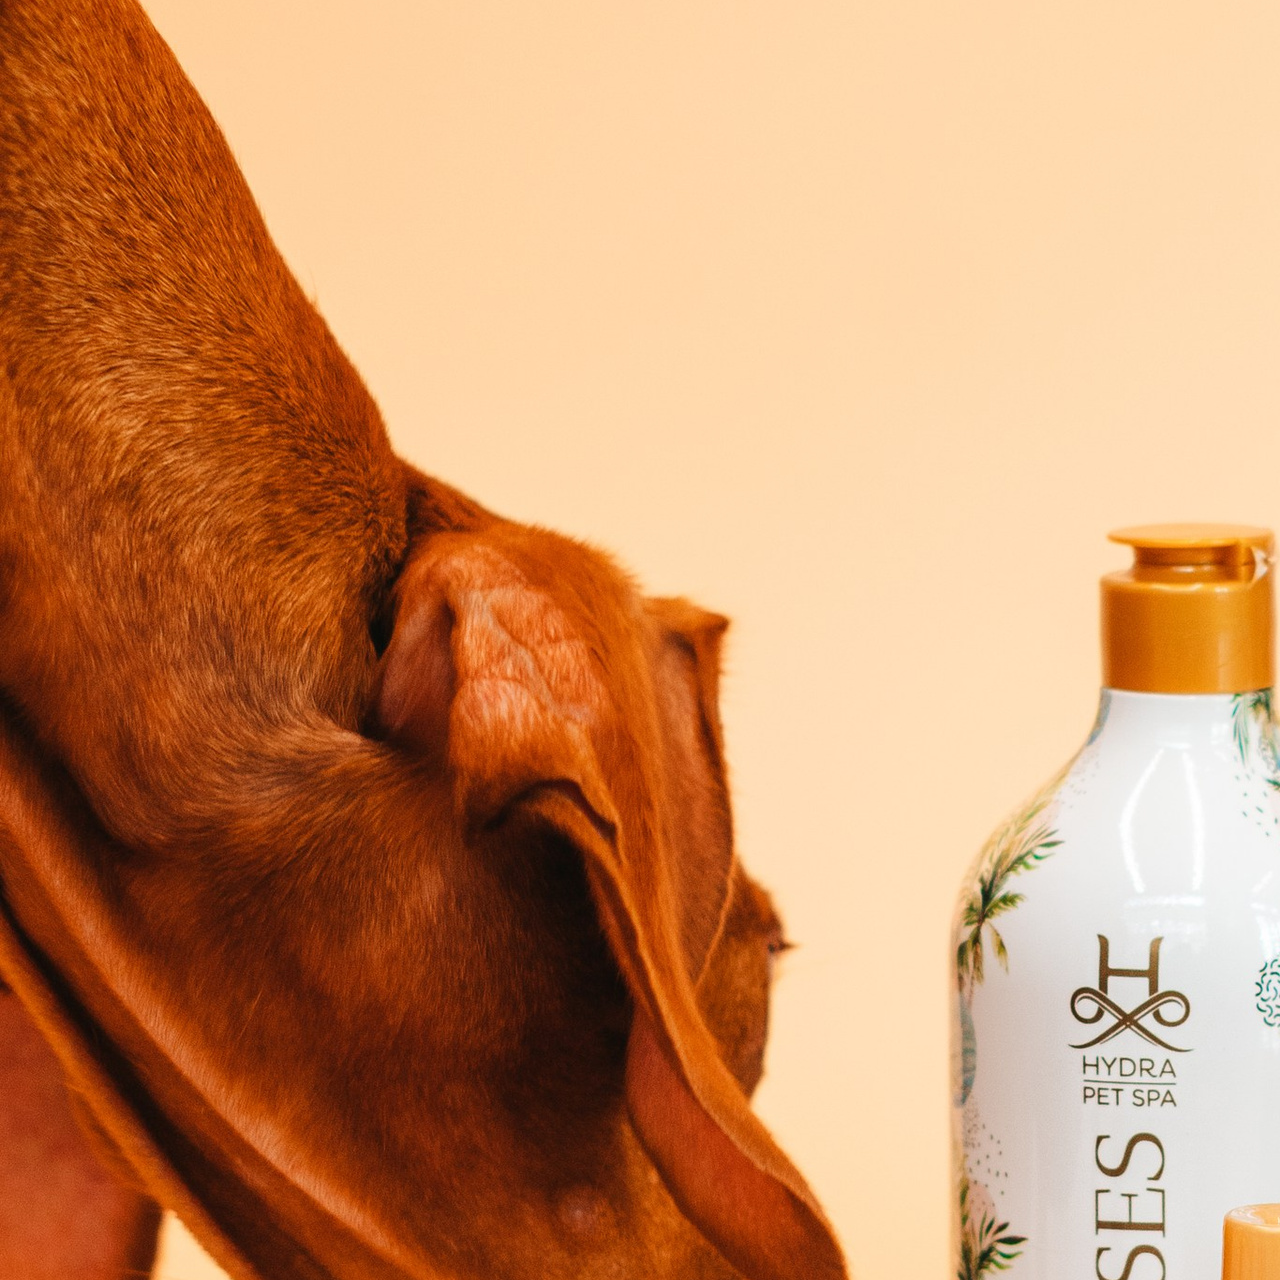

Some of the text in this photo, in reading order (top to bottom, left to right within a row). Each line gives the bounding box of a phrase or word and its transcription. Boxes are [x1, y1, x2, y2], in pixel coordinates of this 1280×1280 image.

[1082, 1054, 1177, 1079] HYDRA
[1083, 1086, 1178, 1108] PET SPA
